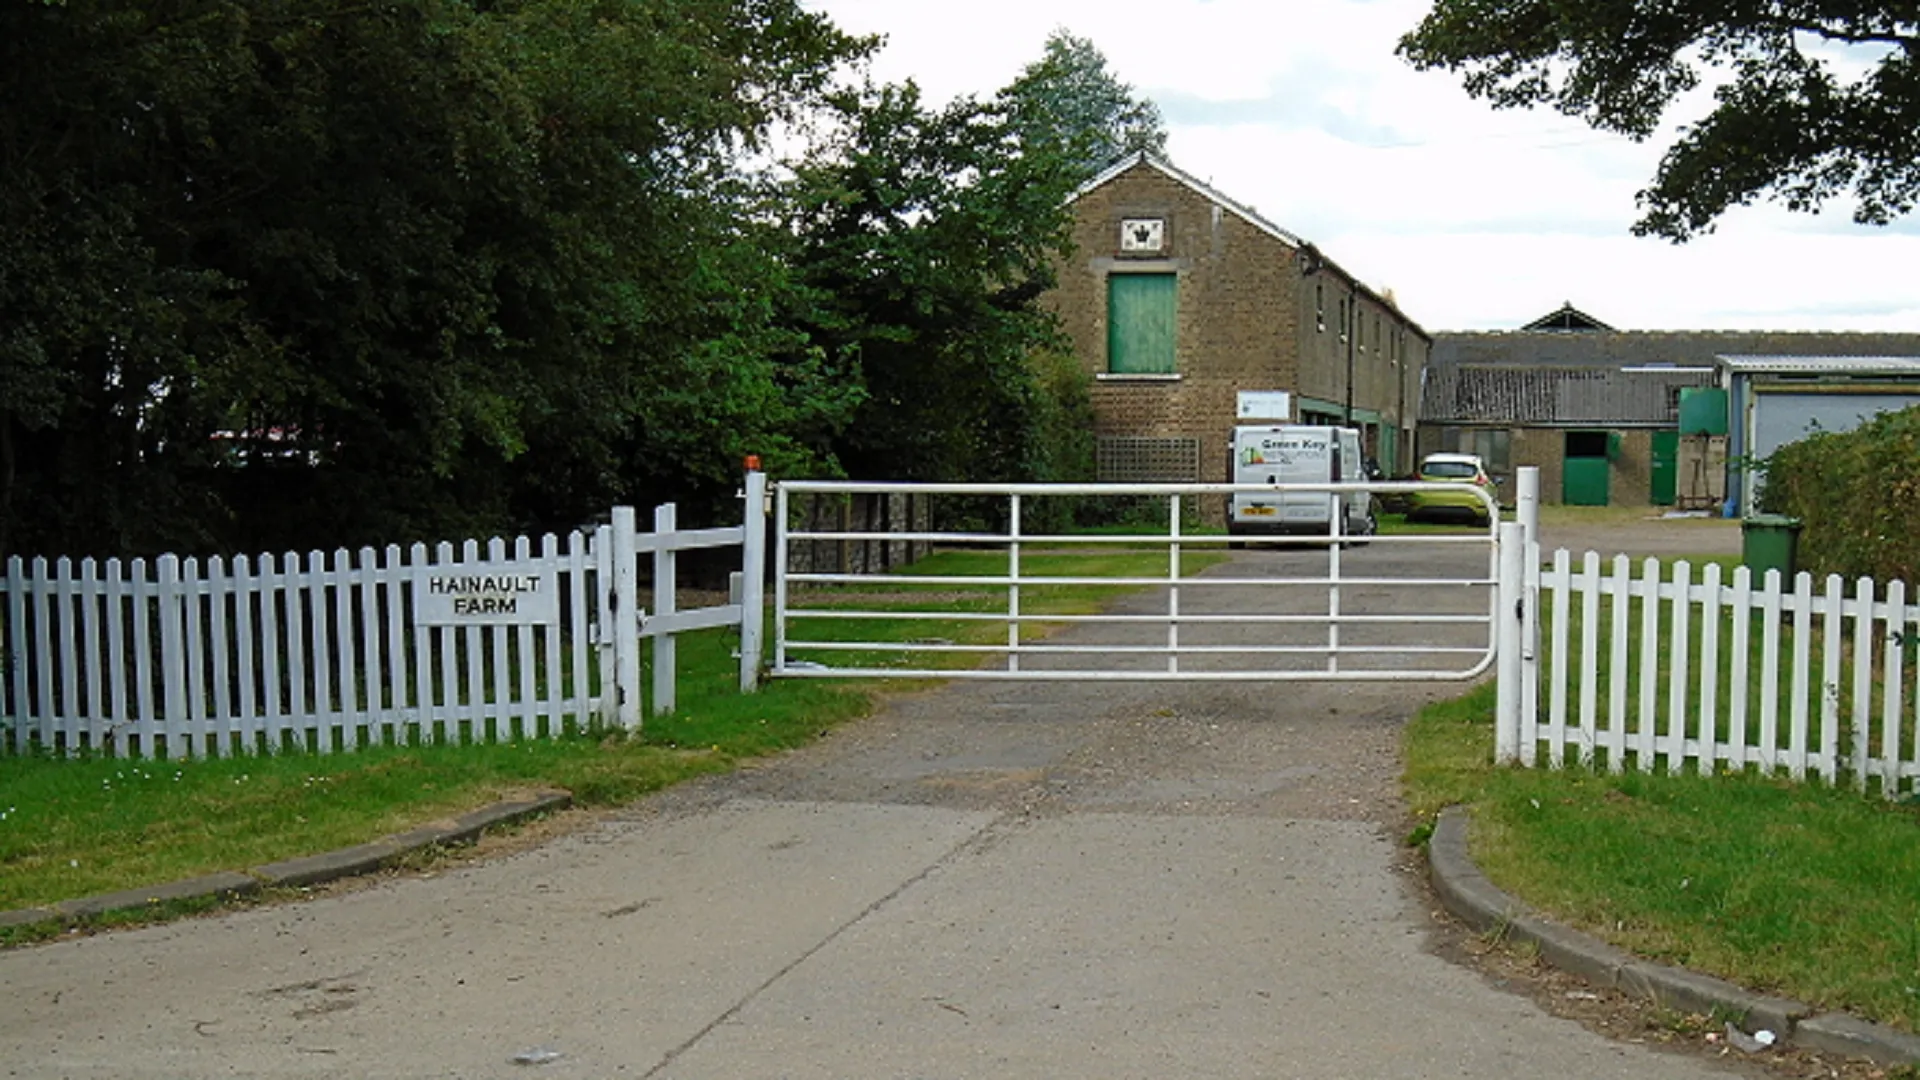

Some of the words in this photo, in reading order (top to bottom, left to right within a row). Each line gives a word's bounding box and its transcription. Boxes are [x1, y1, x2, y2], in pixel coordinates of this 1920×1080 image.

[1262, 439, 1298, 449] Green
[1303, 439, 1326, 451] Key
[430, 576, 541, 593] HAINAULT
[454, 598, 517, 614] FARM
